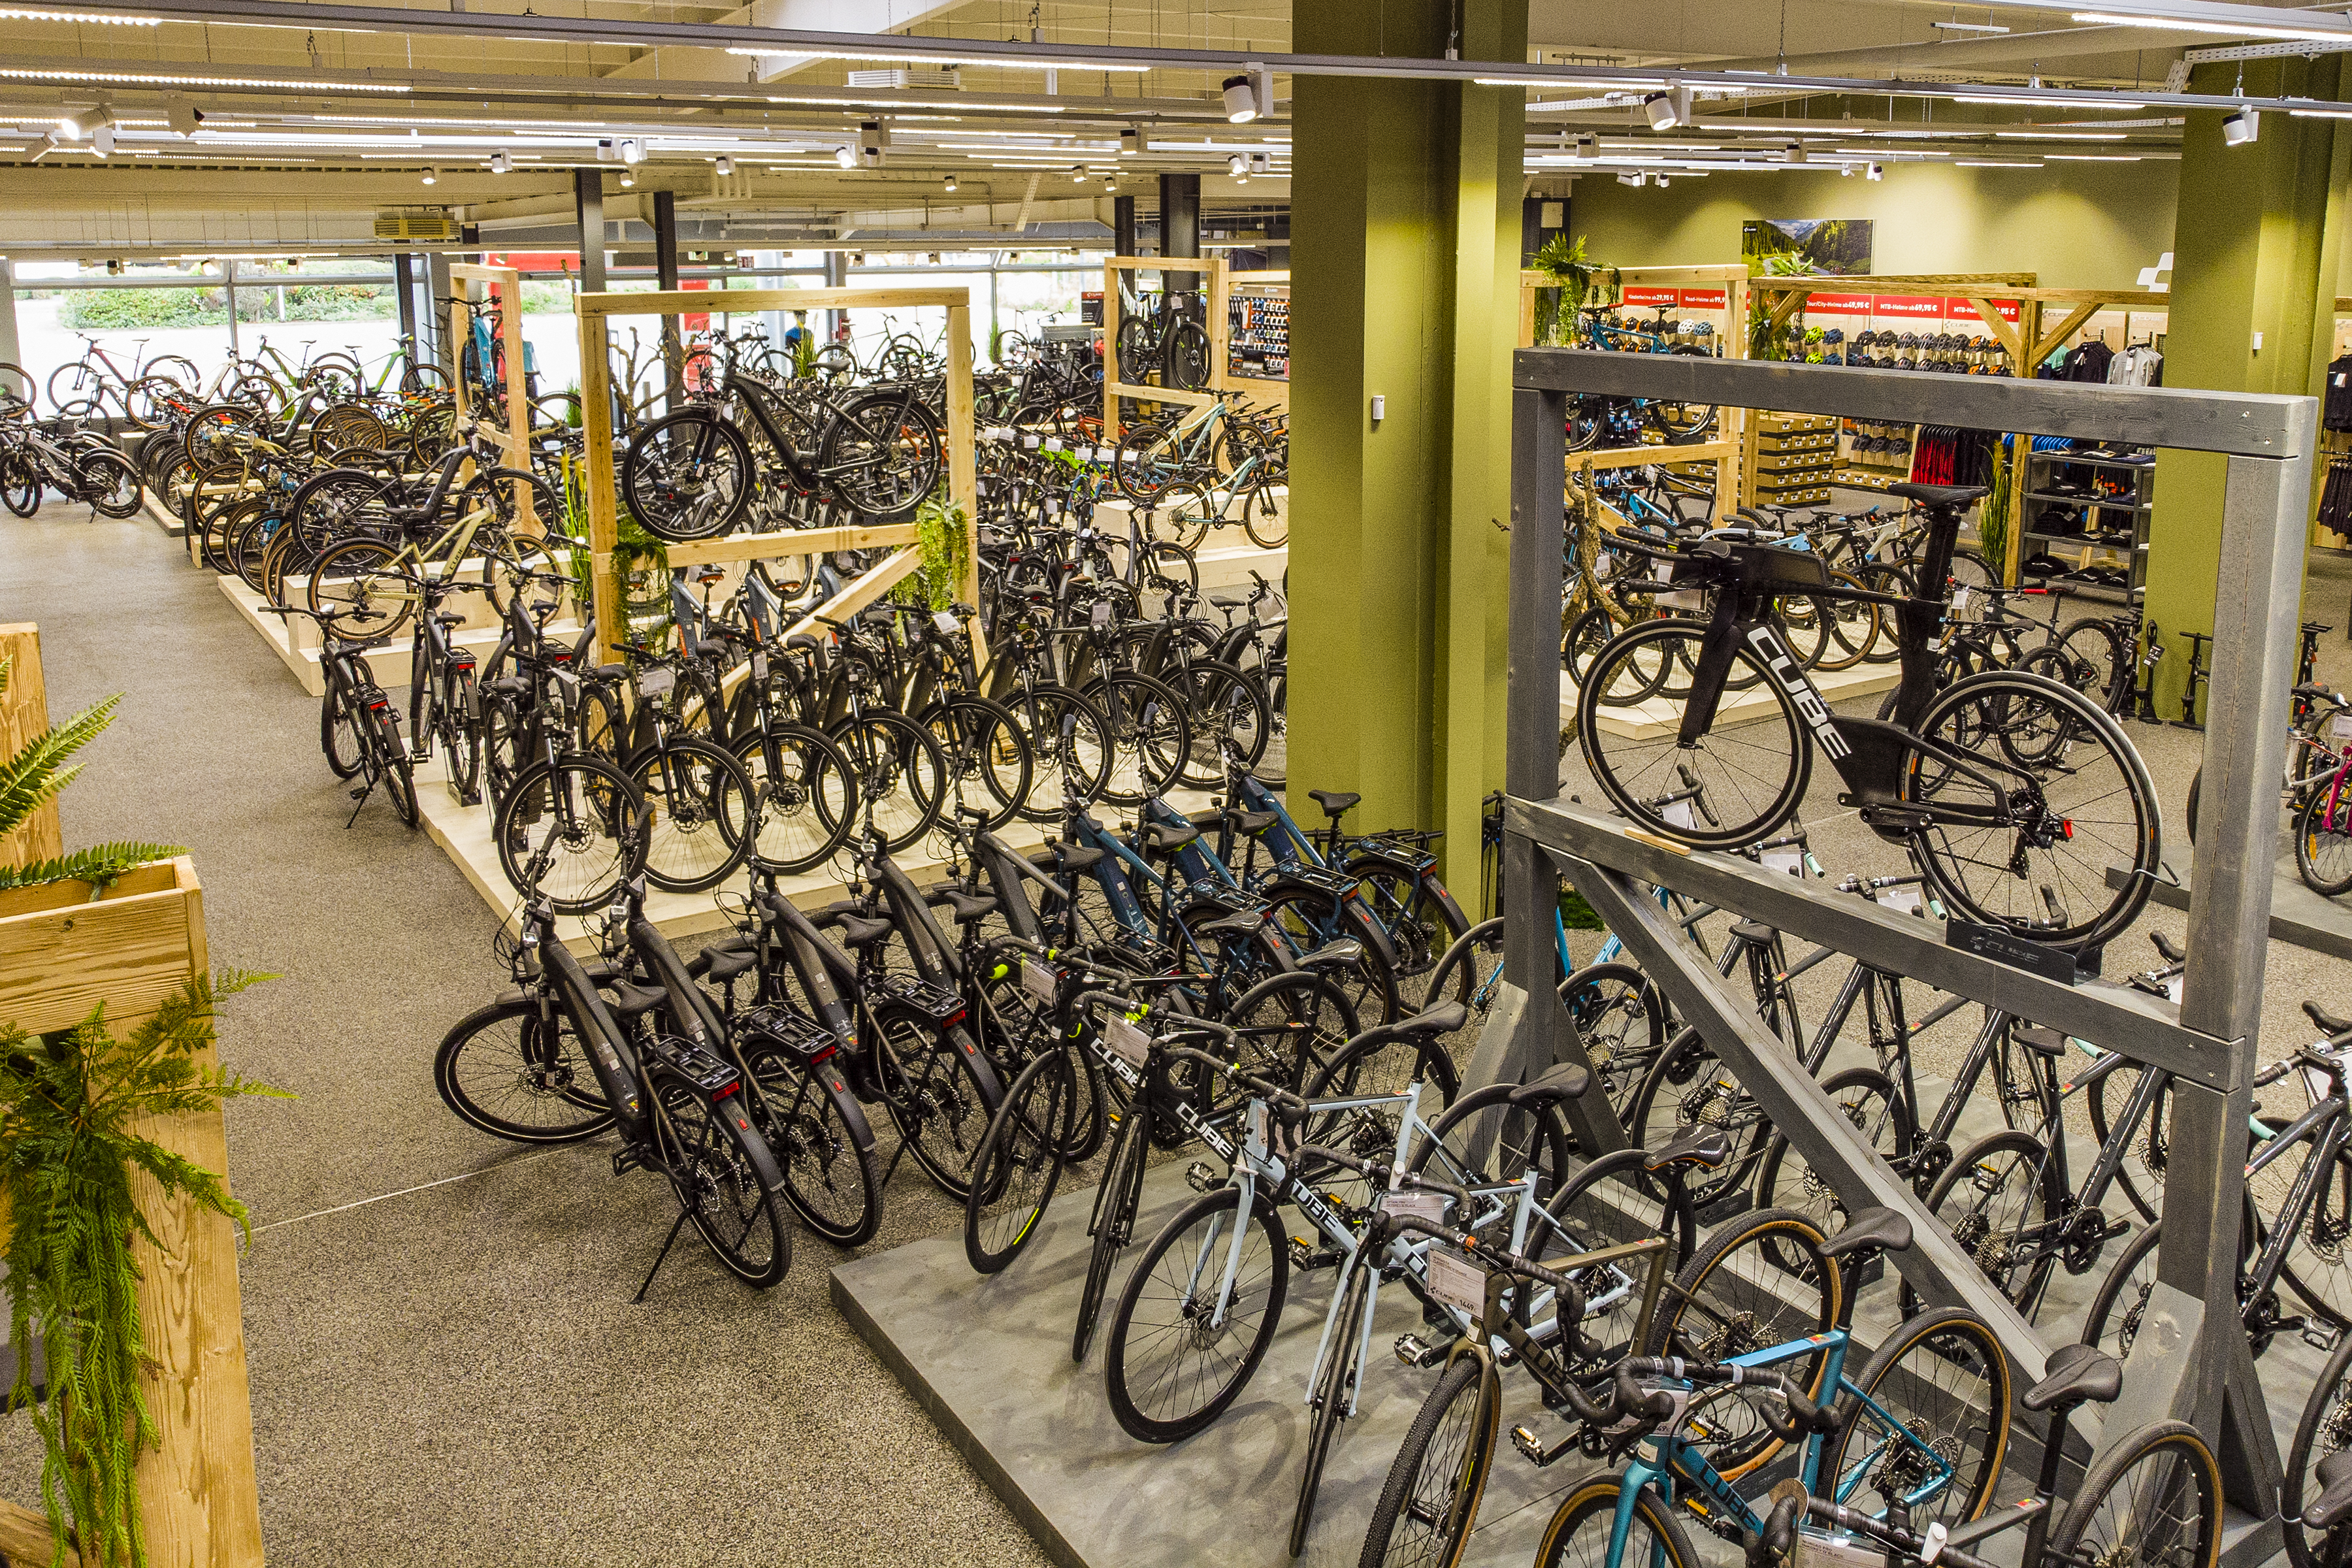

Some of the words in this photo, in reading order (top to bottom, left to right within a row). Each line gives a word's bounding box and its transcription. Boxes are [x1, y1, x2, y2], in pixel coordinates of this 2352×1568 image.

[1914, 304, 1932, 312] 69,95
[1747, 627, 1852, 760] CUBE
[1176, 1102, 1233, 1159] CUBE
[1292, 1181, 1339, 1232] UBE
[1460, 1299, 1475, 1311] 1449
[1520, 1337, 1568, 1388] CUB
[1699, 1463, 1759, 1531] CUBE
